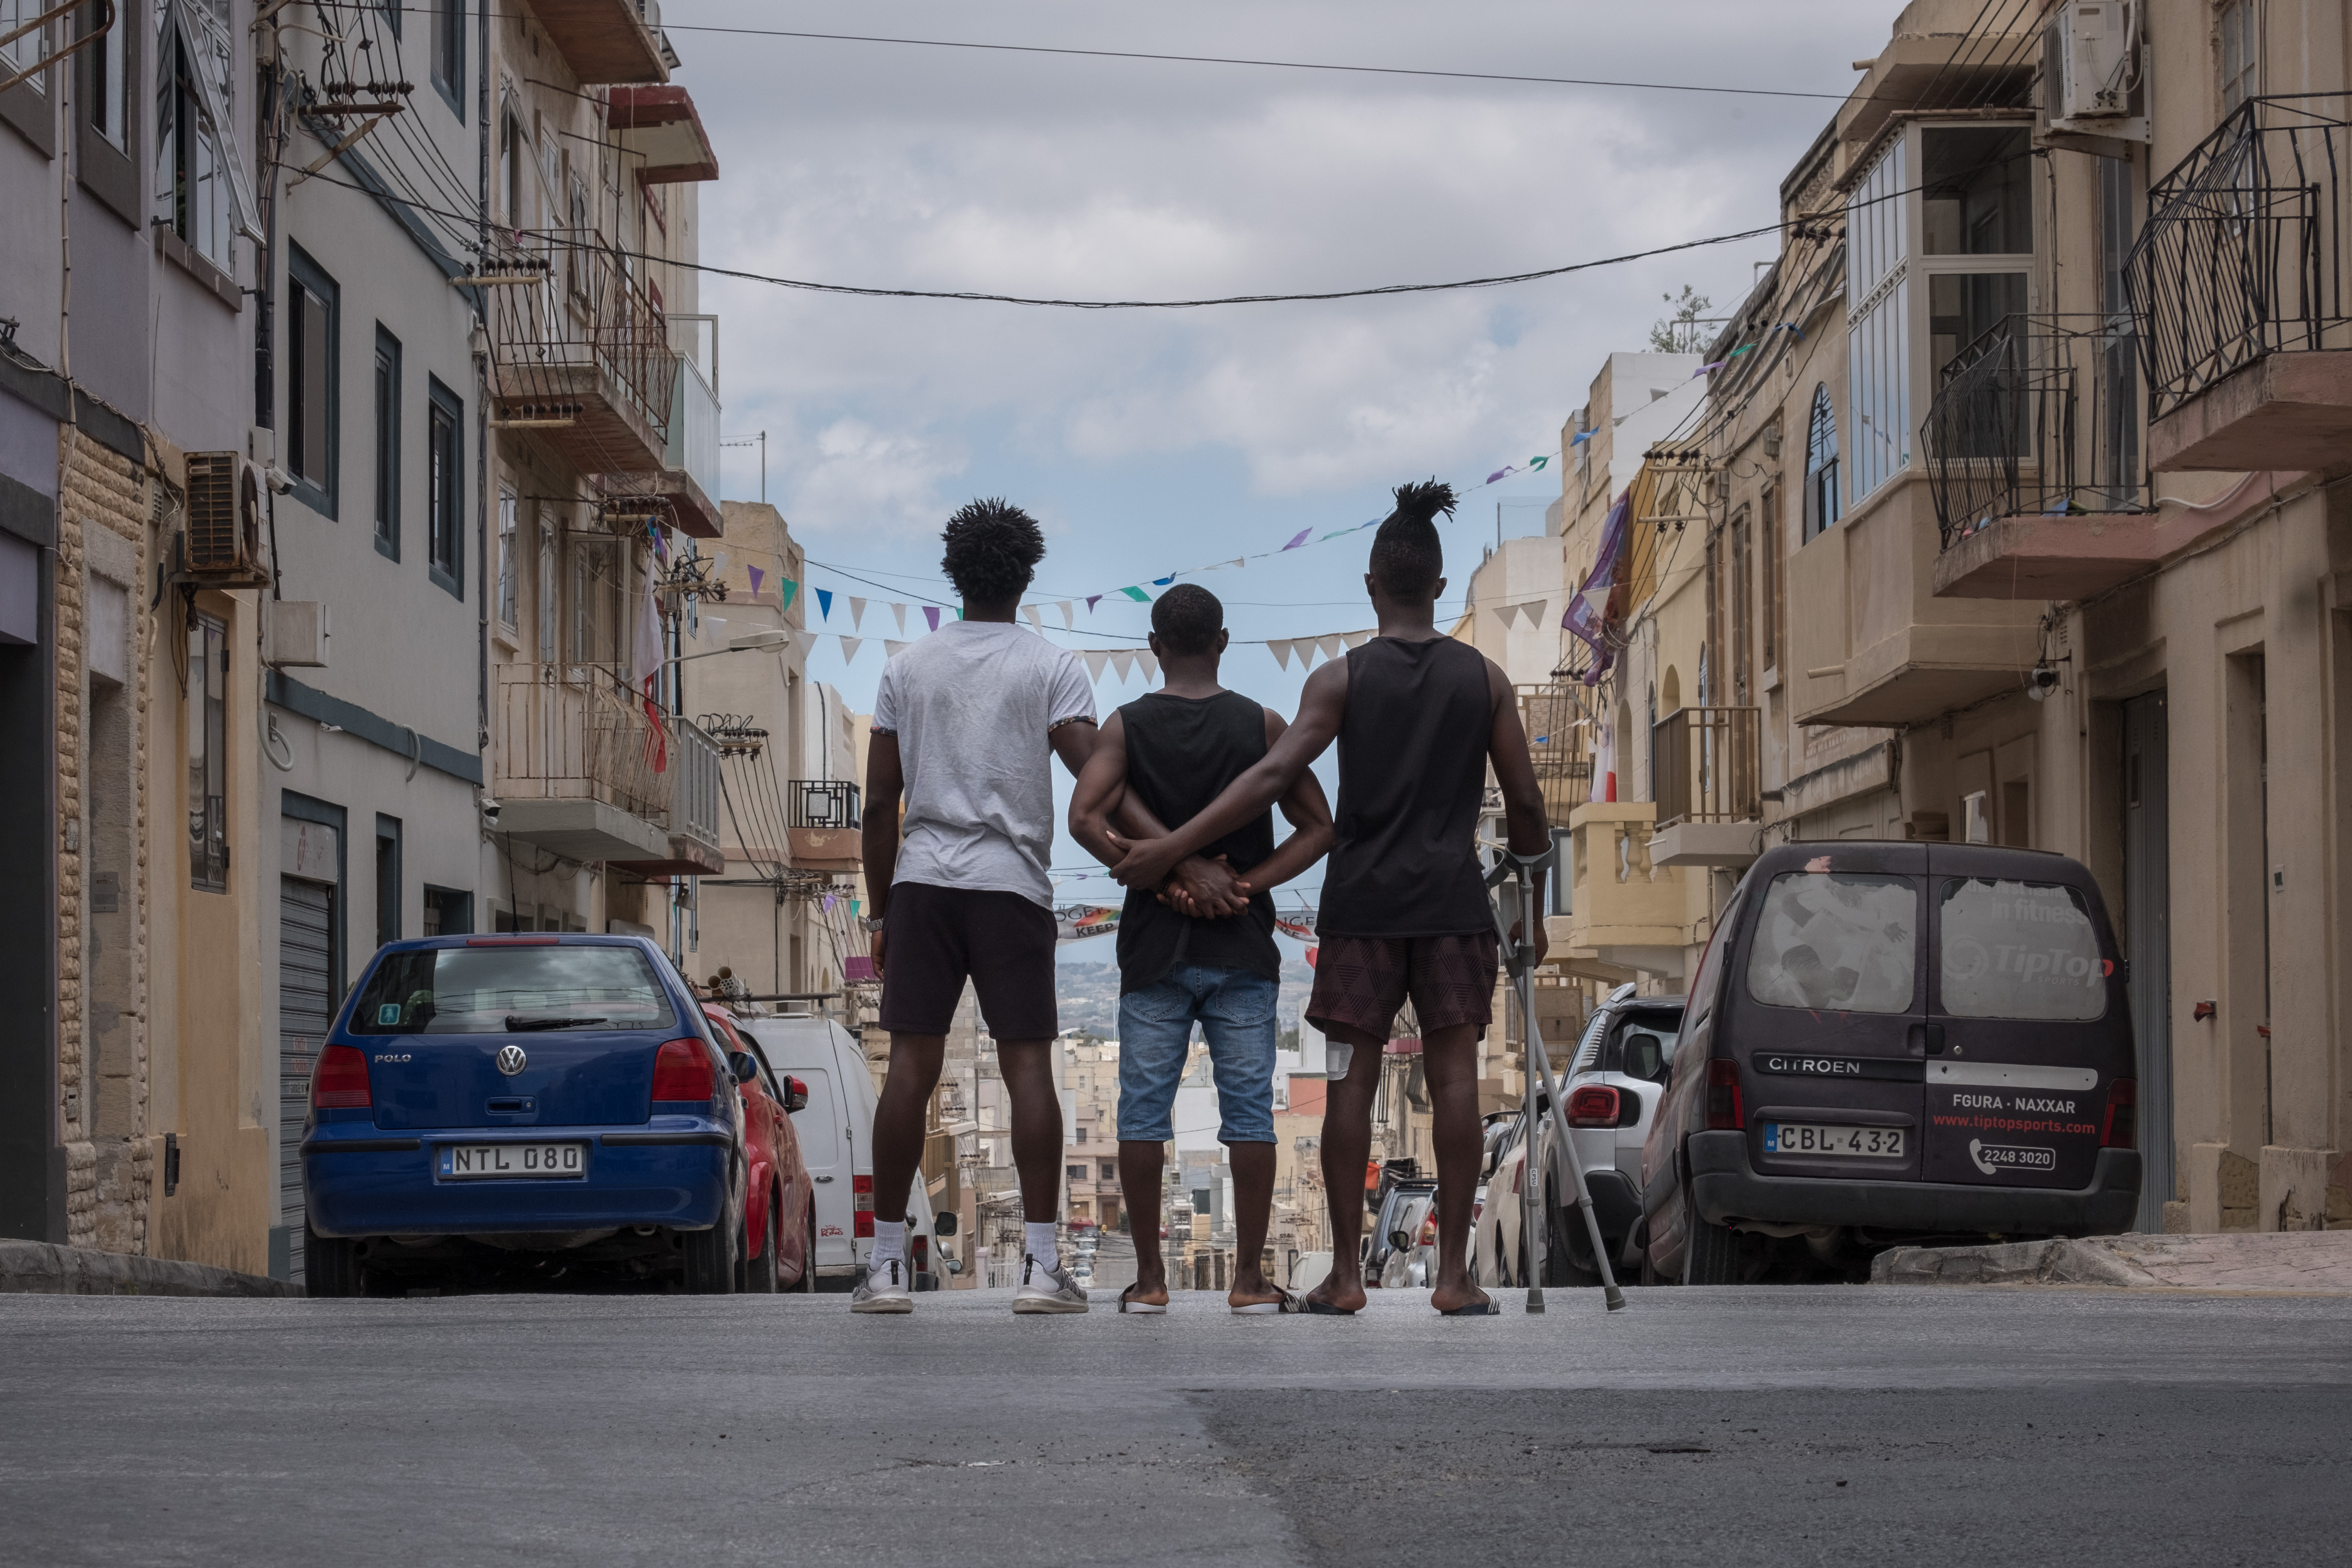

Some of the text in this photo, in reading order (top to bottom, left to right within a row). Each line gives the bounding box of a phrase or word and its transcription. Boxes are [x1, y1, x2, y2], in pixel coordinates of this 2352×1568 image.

[1991, 897, 2090, 925] in fitness
[1076, 923, 1114, 937] KEEP
[1995, 944, 2114, 987] TipTop
[2037, 976, 2080, 985] SPORTS
[374, 1054, 411, 1063] POLO
[1953, 1094, 2075, 1114] FGURA NAXXAR
[1933, 1115, 2095, 1134] www.tiptopsports.com
[1782, 1127, 1900, 1153] CBL 432
[456, 1148, 577, 1171] NTL 080
[1984, 1150, 2050, 1165] 2248 3020
